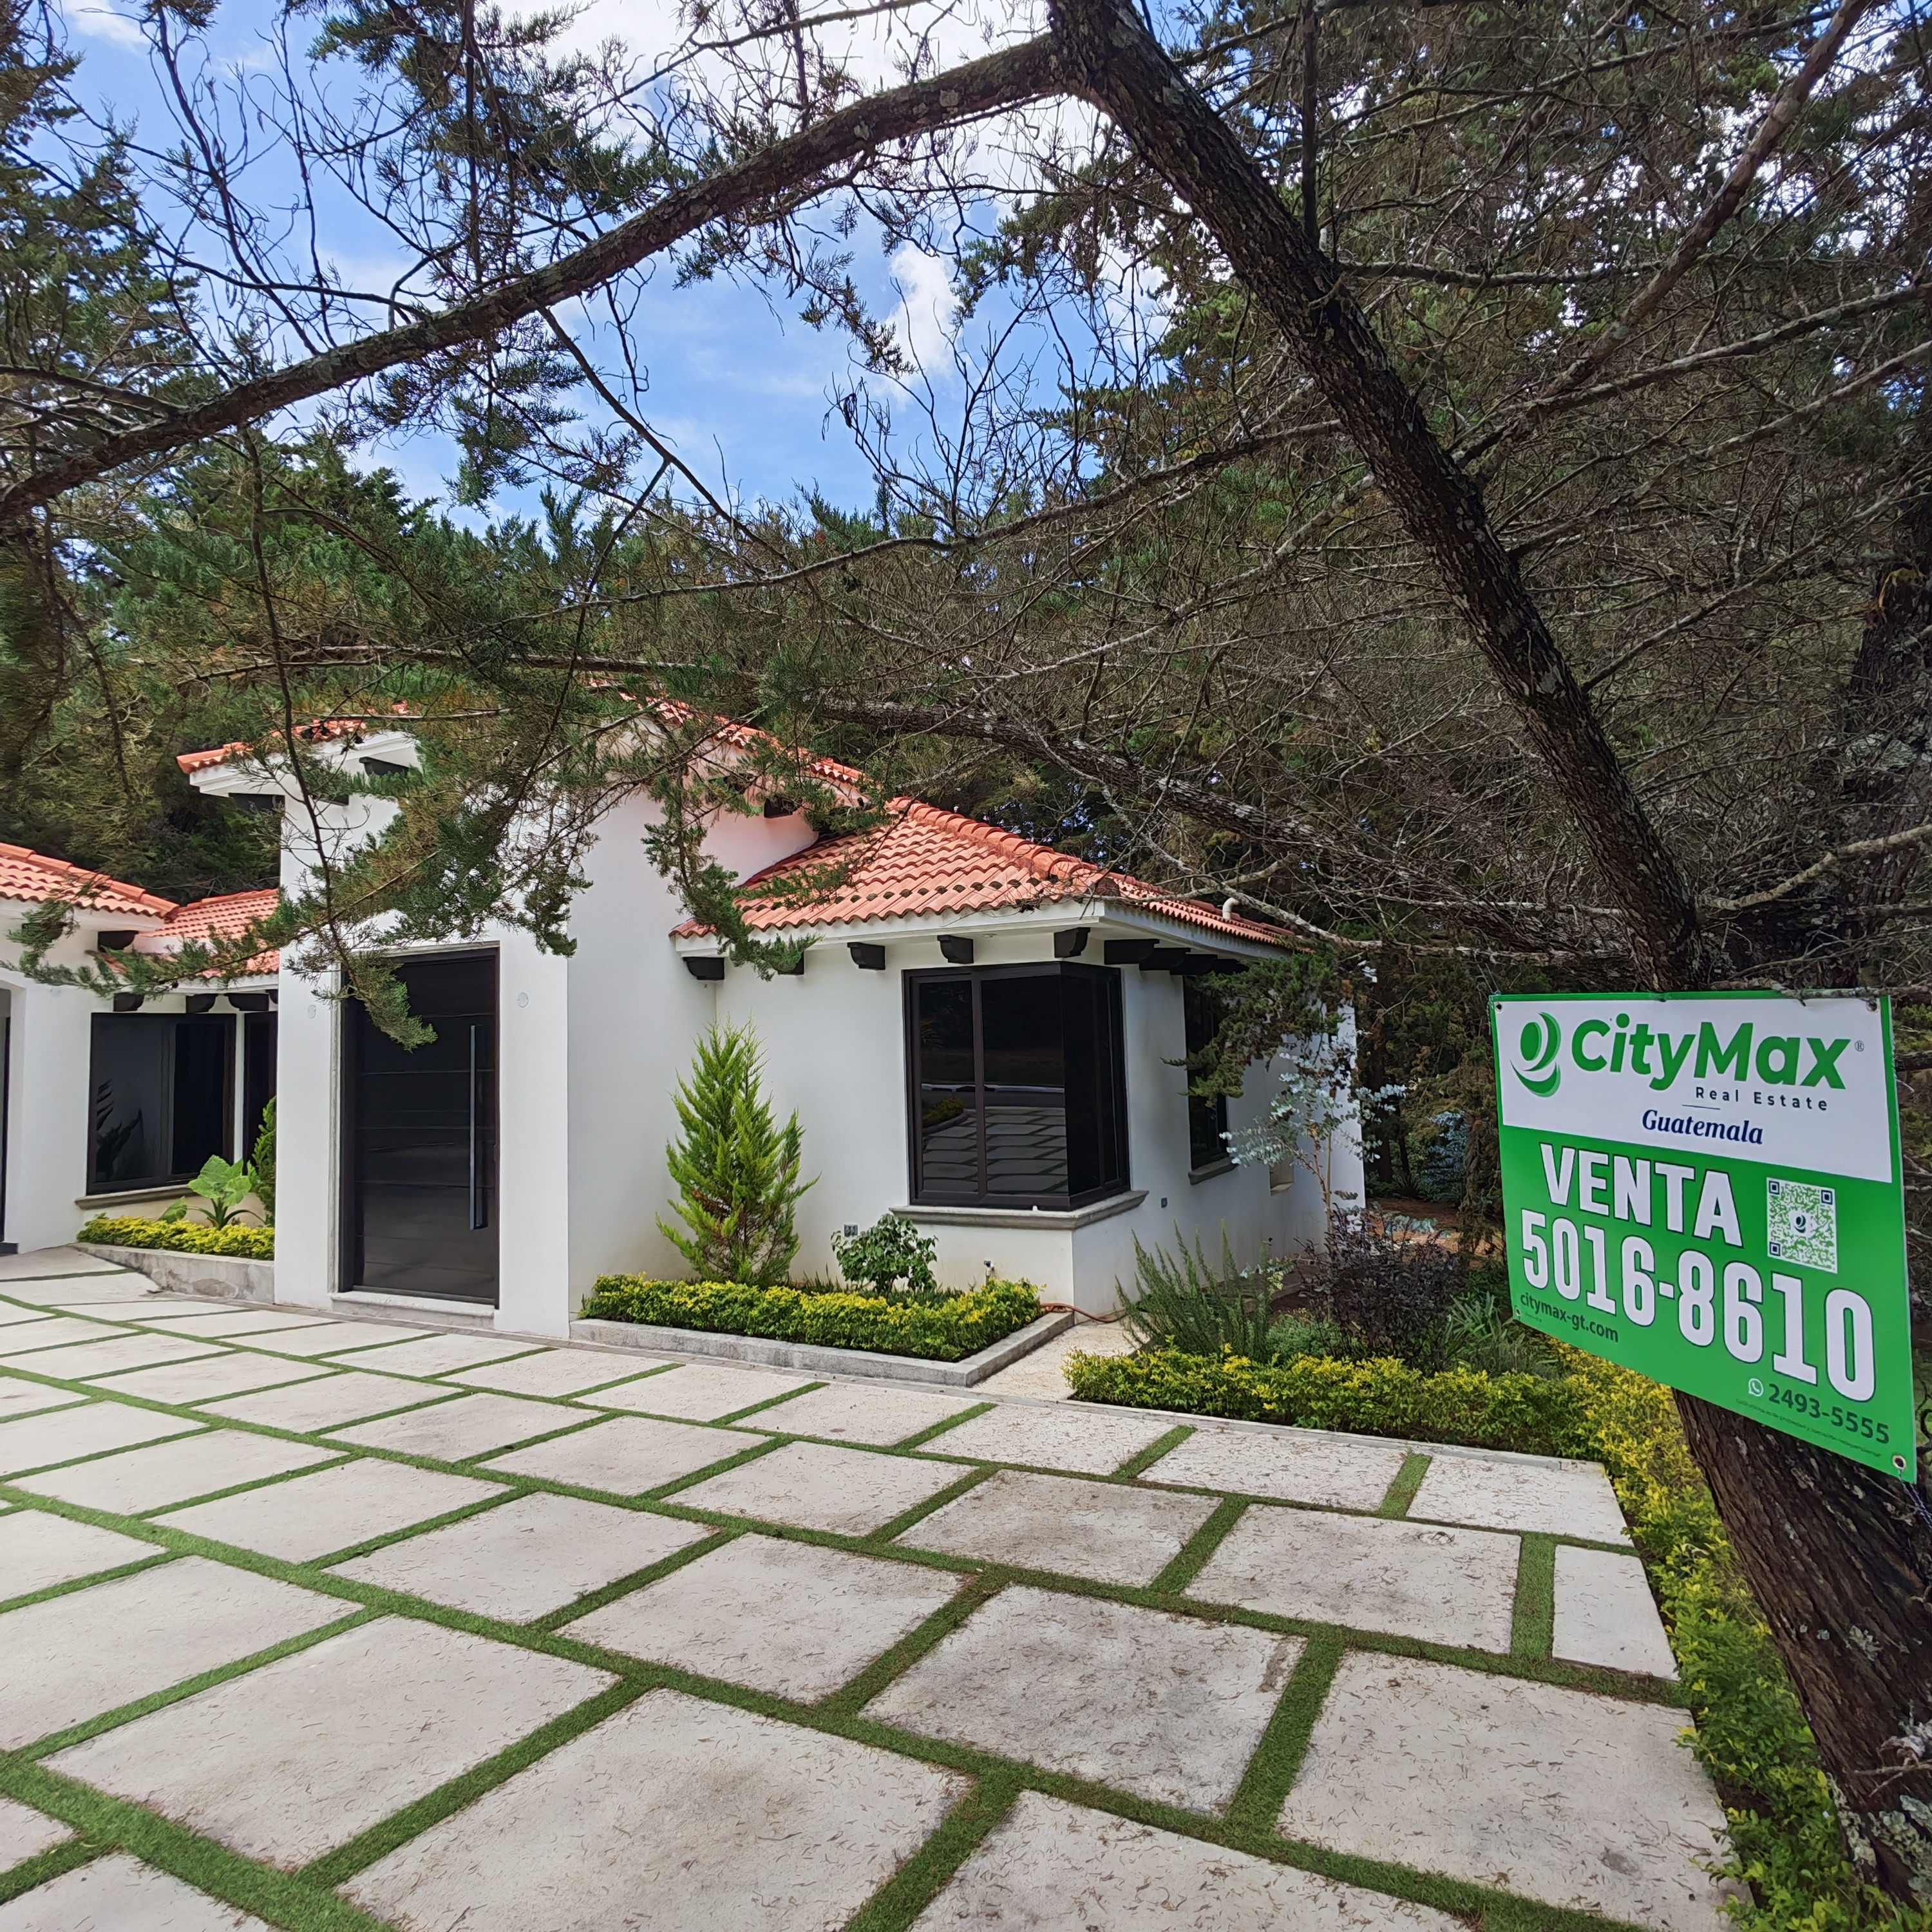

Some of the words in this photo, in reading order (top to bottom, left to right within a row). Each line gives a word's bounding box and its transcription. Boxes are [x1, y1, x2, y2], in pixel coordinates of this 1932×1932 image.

[1571, 1013, 1852, 1090] CityMax
[1642, 1109, 1764, 1144] Guatemala
[1696, 1086, 1739, 1102] Real
[1754, 1092, 1828, 1111] Estate
[1540, 1142, 1743, 1248] VENTA
[1520, 1292, 1618, 1343] citymax-gt.com
[1521, 1208, 1876, 1401] 5016-8610
[1768, 1383, 1889, 1444] 2493-5555
